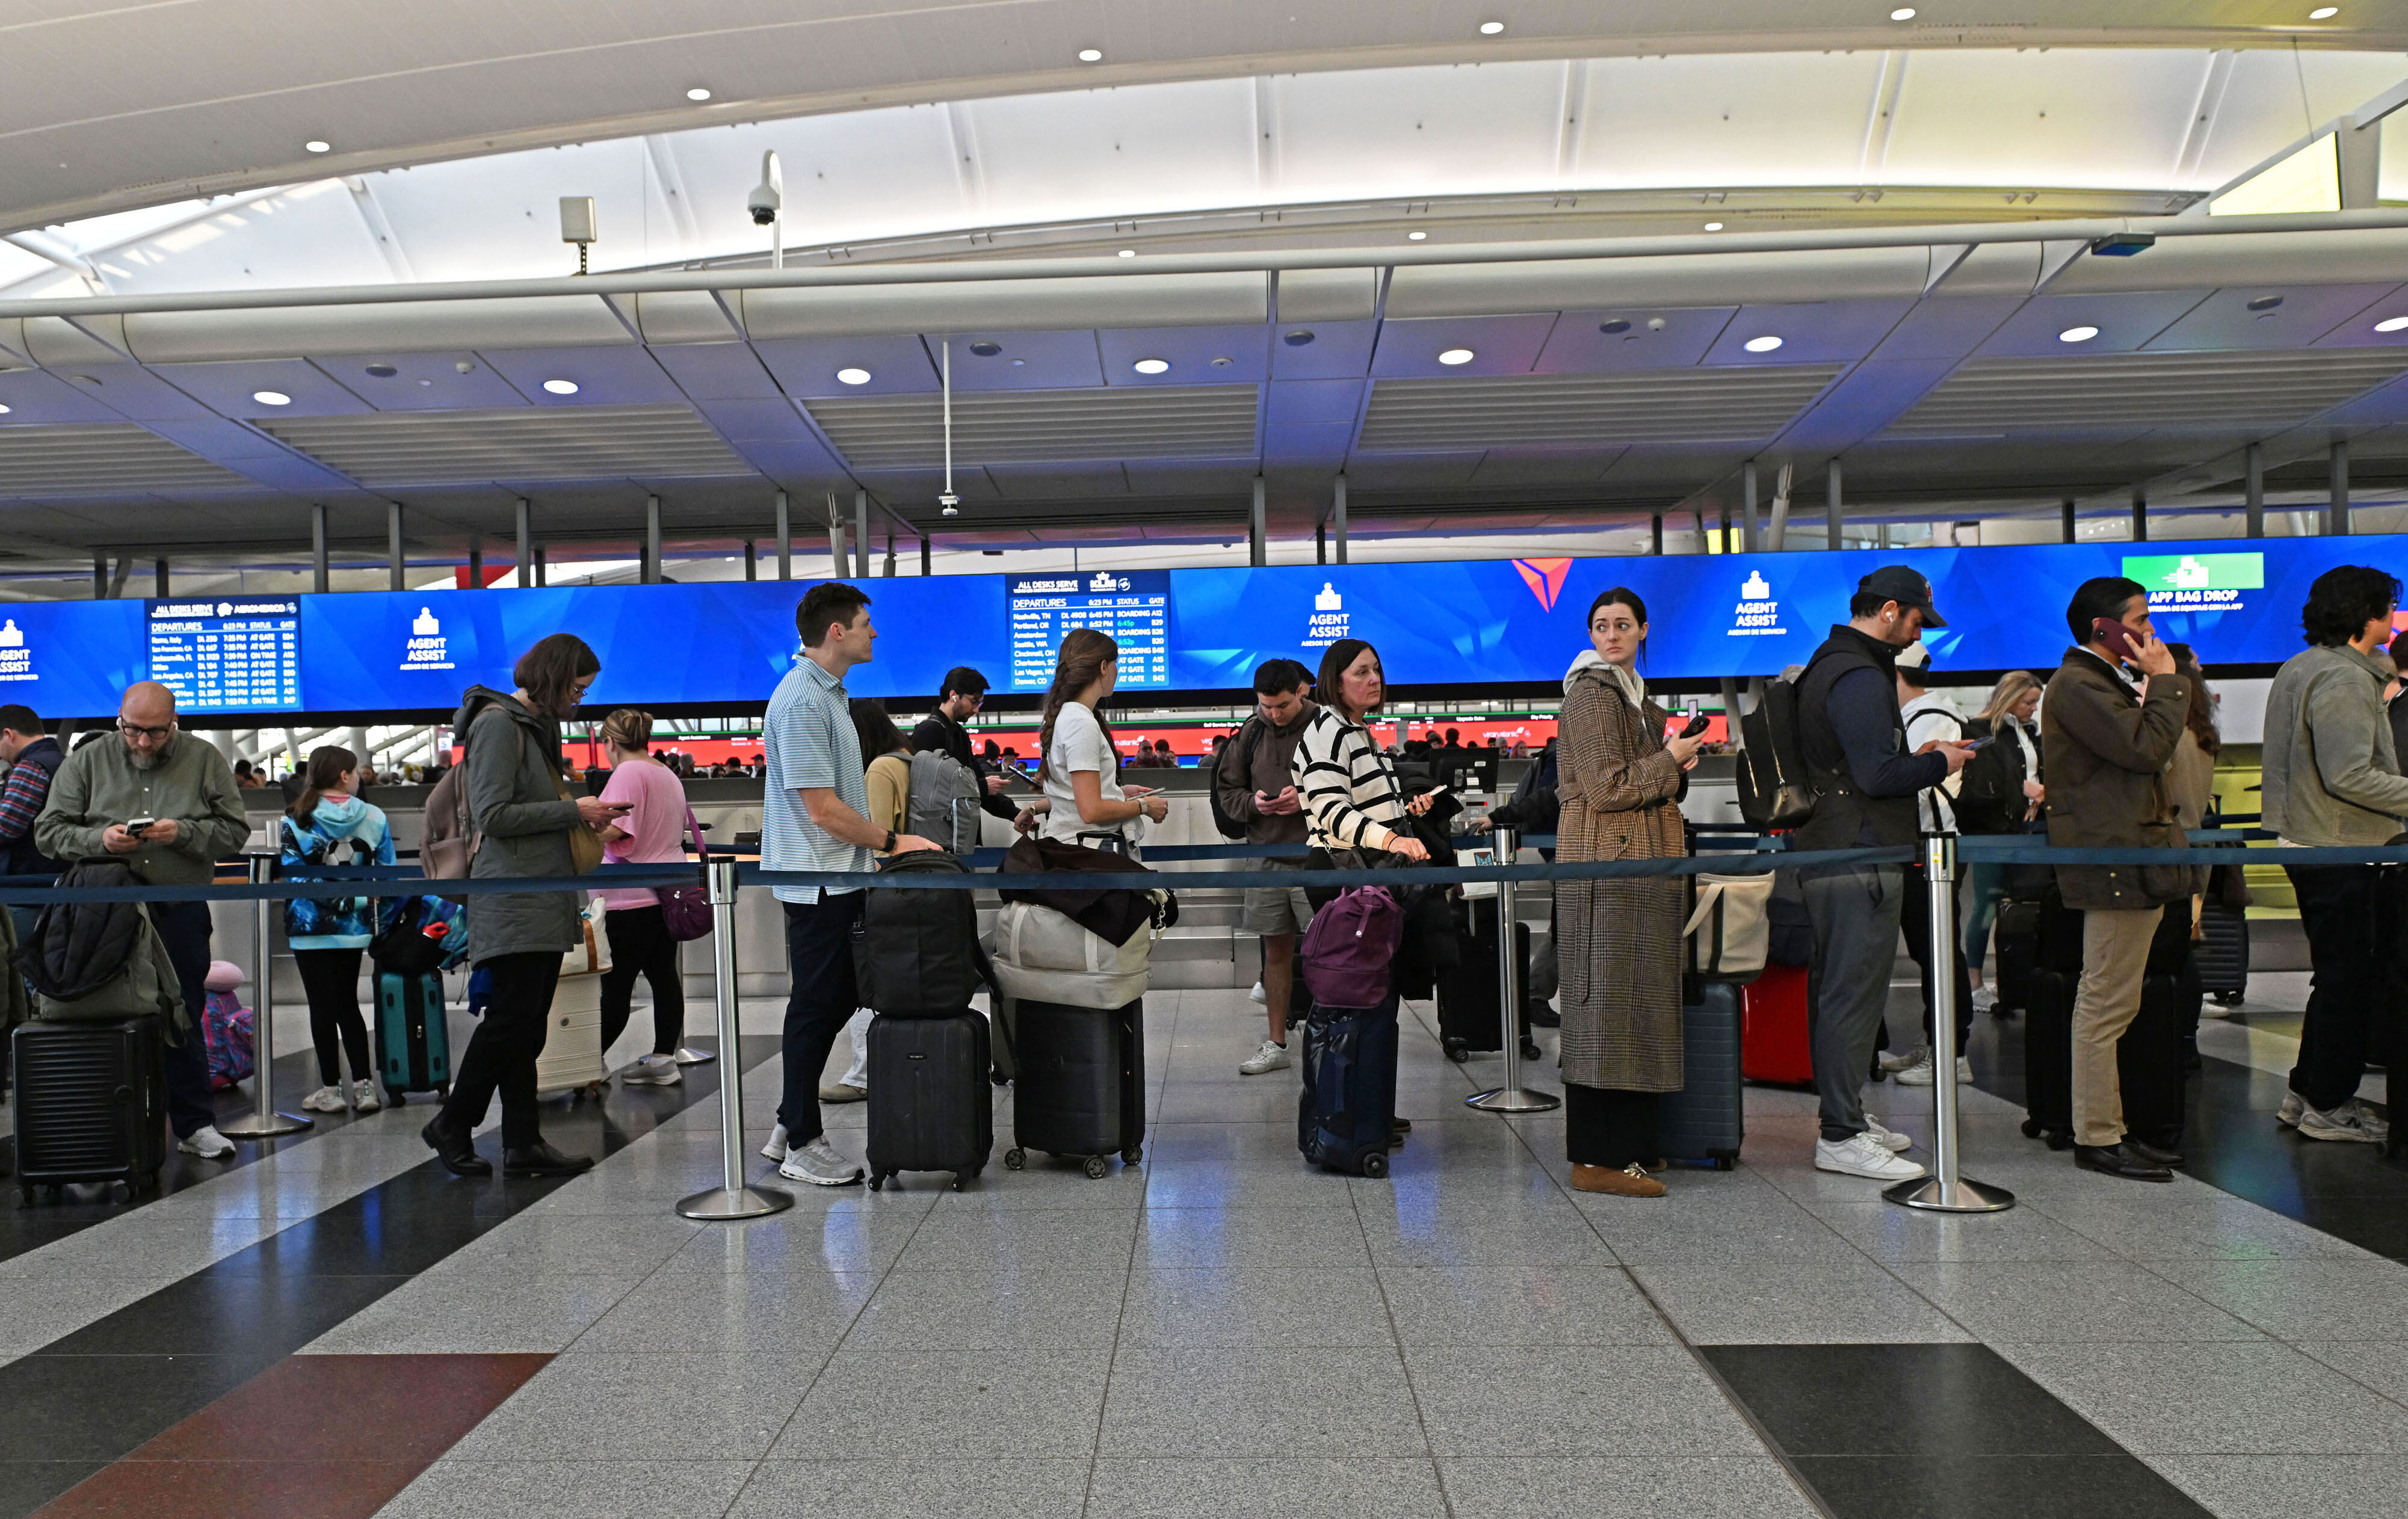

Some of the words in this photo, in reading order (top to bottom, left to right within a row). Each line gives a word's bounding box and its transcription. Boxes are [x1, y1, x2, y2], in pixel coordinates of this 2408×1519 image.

[1090, 579, 1117, 588] KLM
[2149, 591, 2173, 603] APP
[2175, 591, 2202, 602] BAG
[2203, 590, 2238, 602] DROP
[1013, 599, 1067, 608] DEPARTURES
[1735, 602, 1777, 614] AGENT
[1309, 614, 1350, 625] AGENT
[1736, 614, 1777, 627] ASSIST
[152, 622, 203, 632] DEPARTURES
[1309, 626, 1350, 638] ASSIST
[407, 638, 446, 649] AGENT
[407, 650, 446, 661] ASSIST
[1025, 668, 1045, 677] Vegas,
